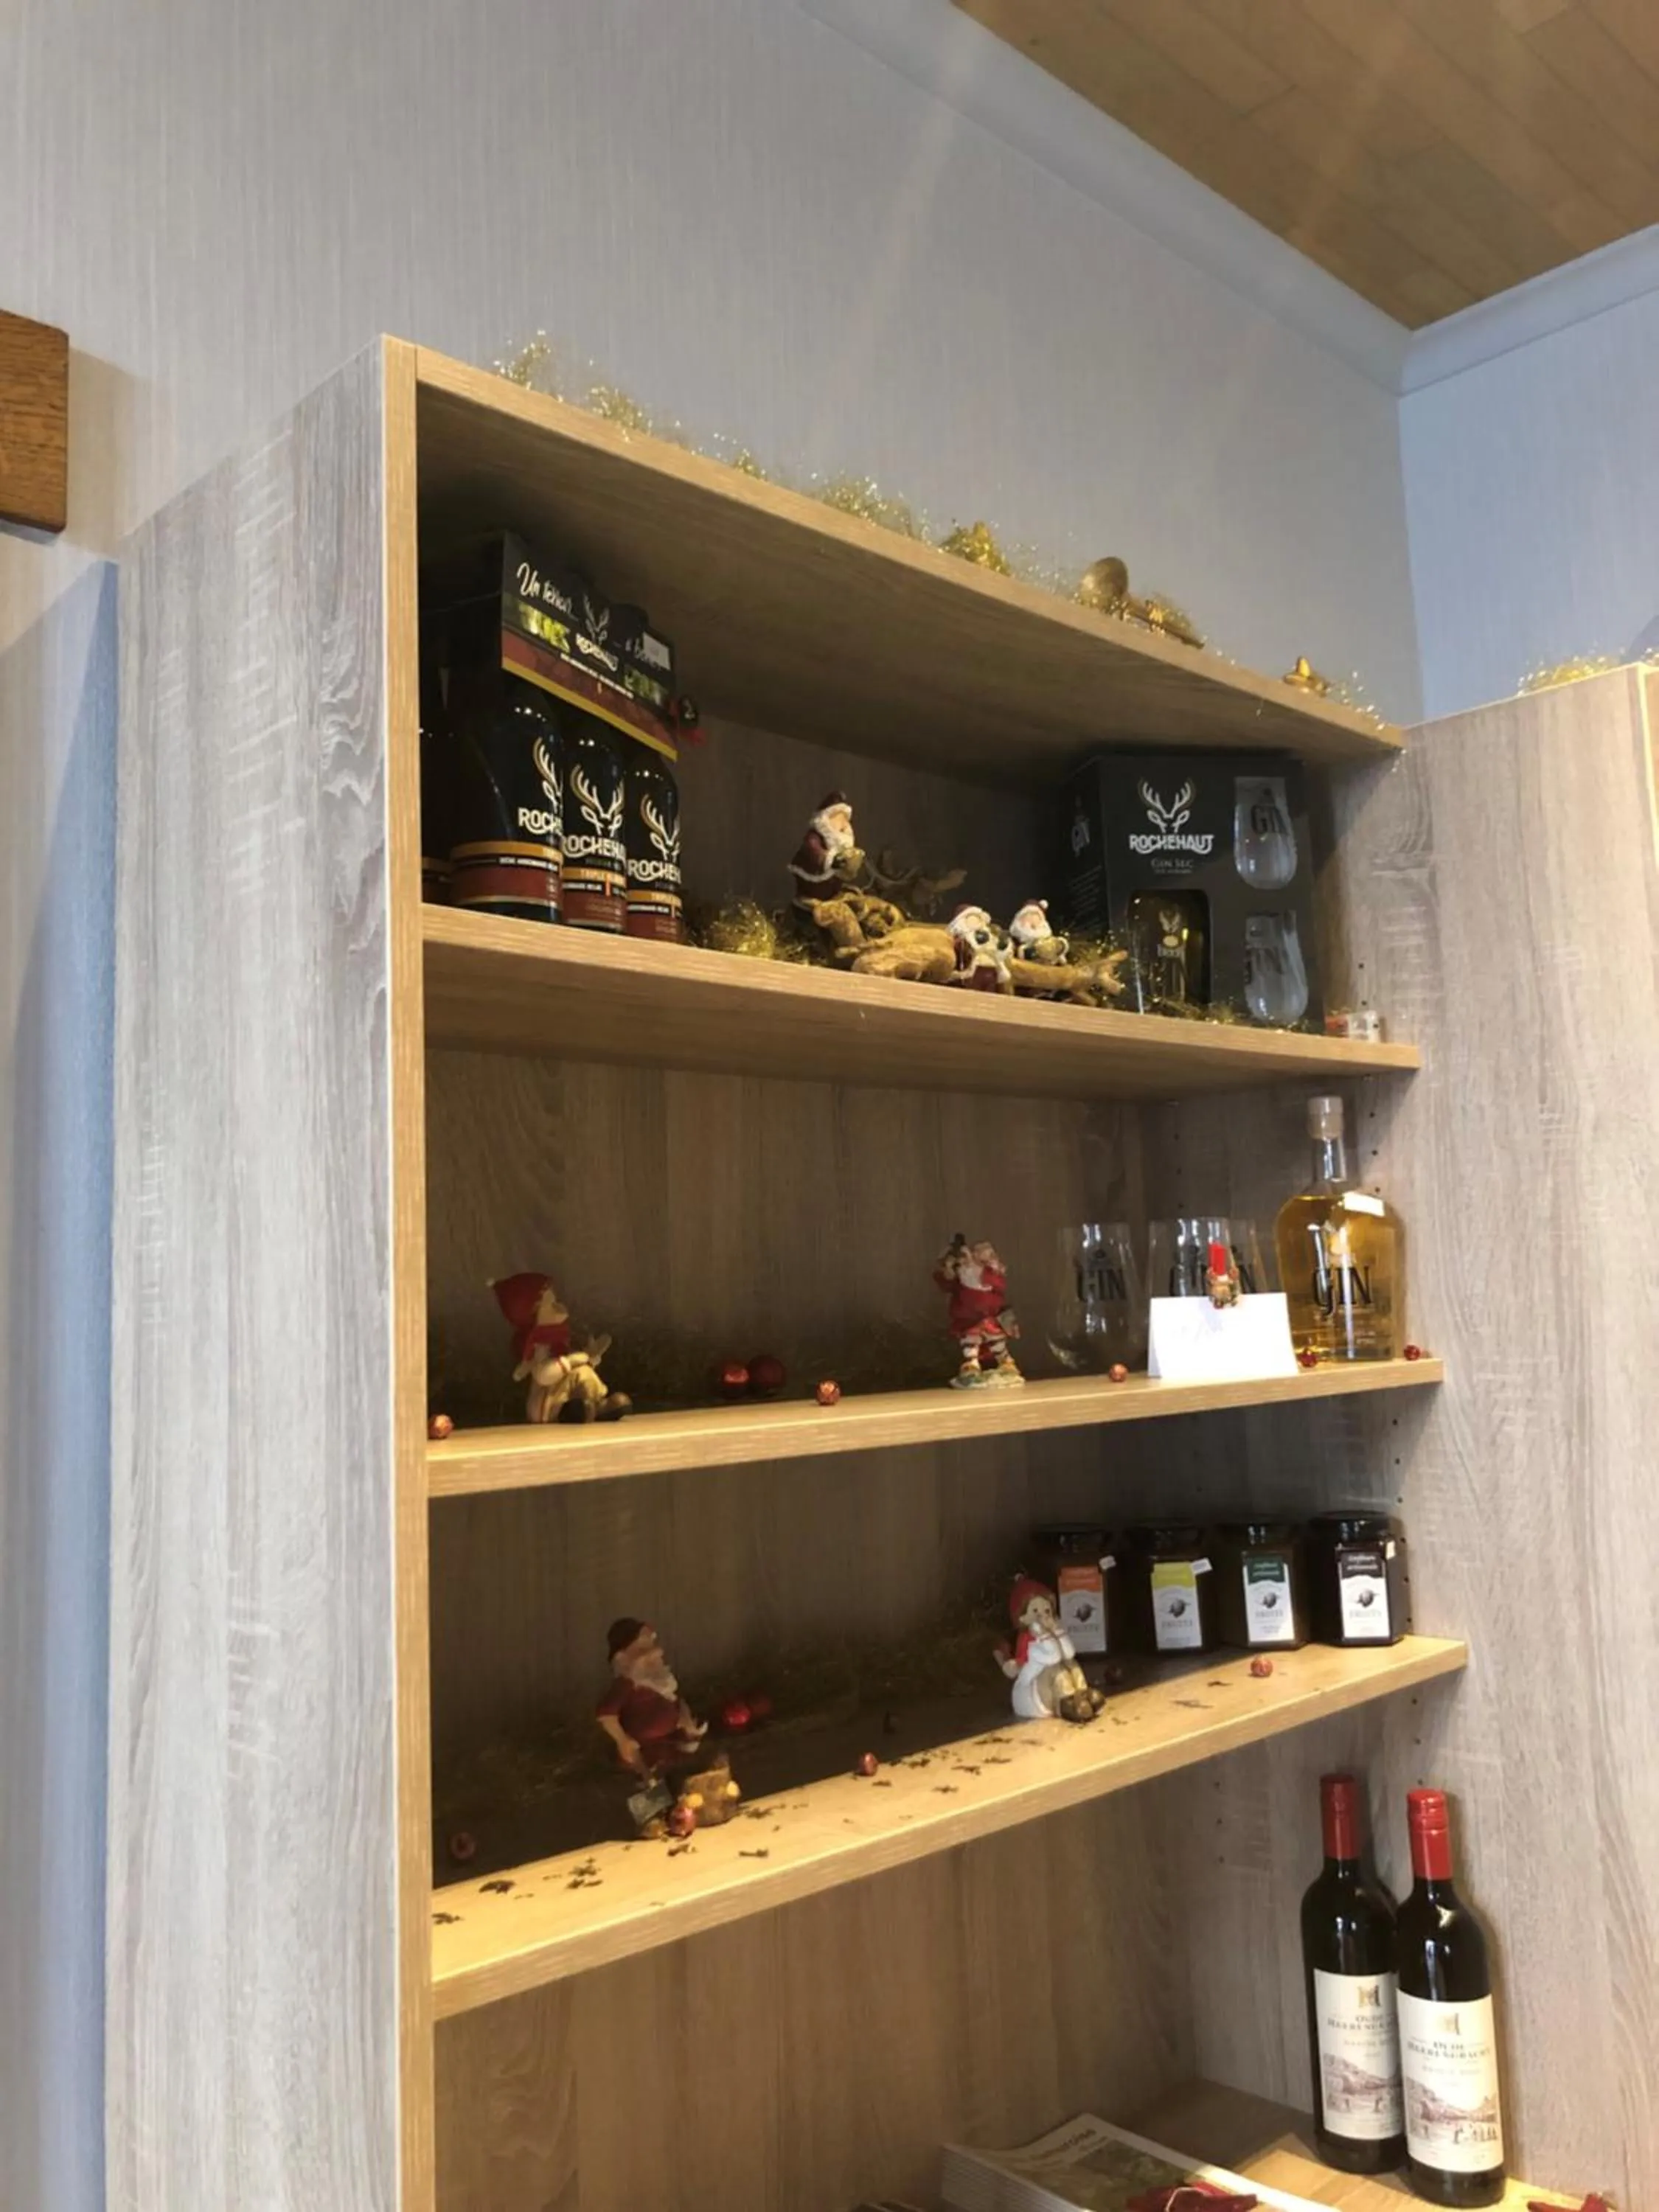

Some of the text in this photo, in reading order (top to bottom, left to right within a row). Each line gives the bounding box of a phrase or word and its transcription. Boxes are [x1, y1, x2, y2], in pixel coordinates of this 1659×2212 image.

[1129, 833, 1214, 855] ROCHEHAUT
[1077, 1265, 1126, 1302] GIN
[1312, 1266, 1371, 1315] GIN
